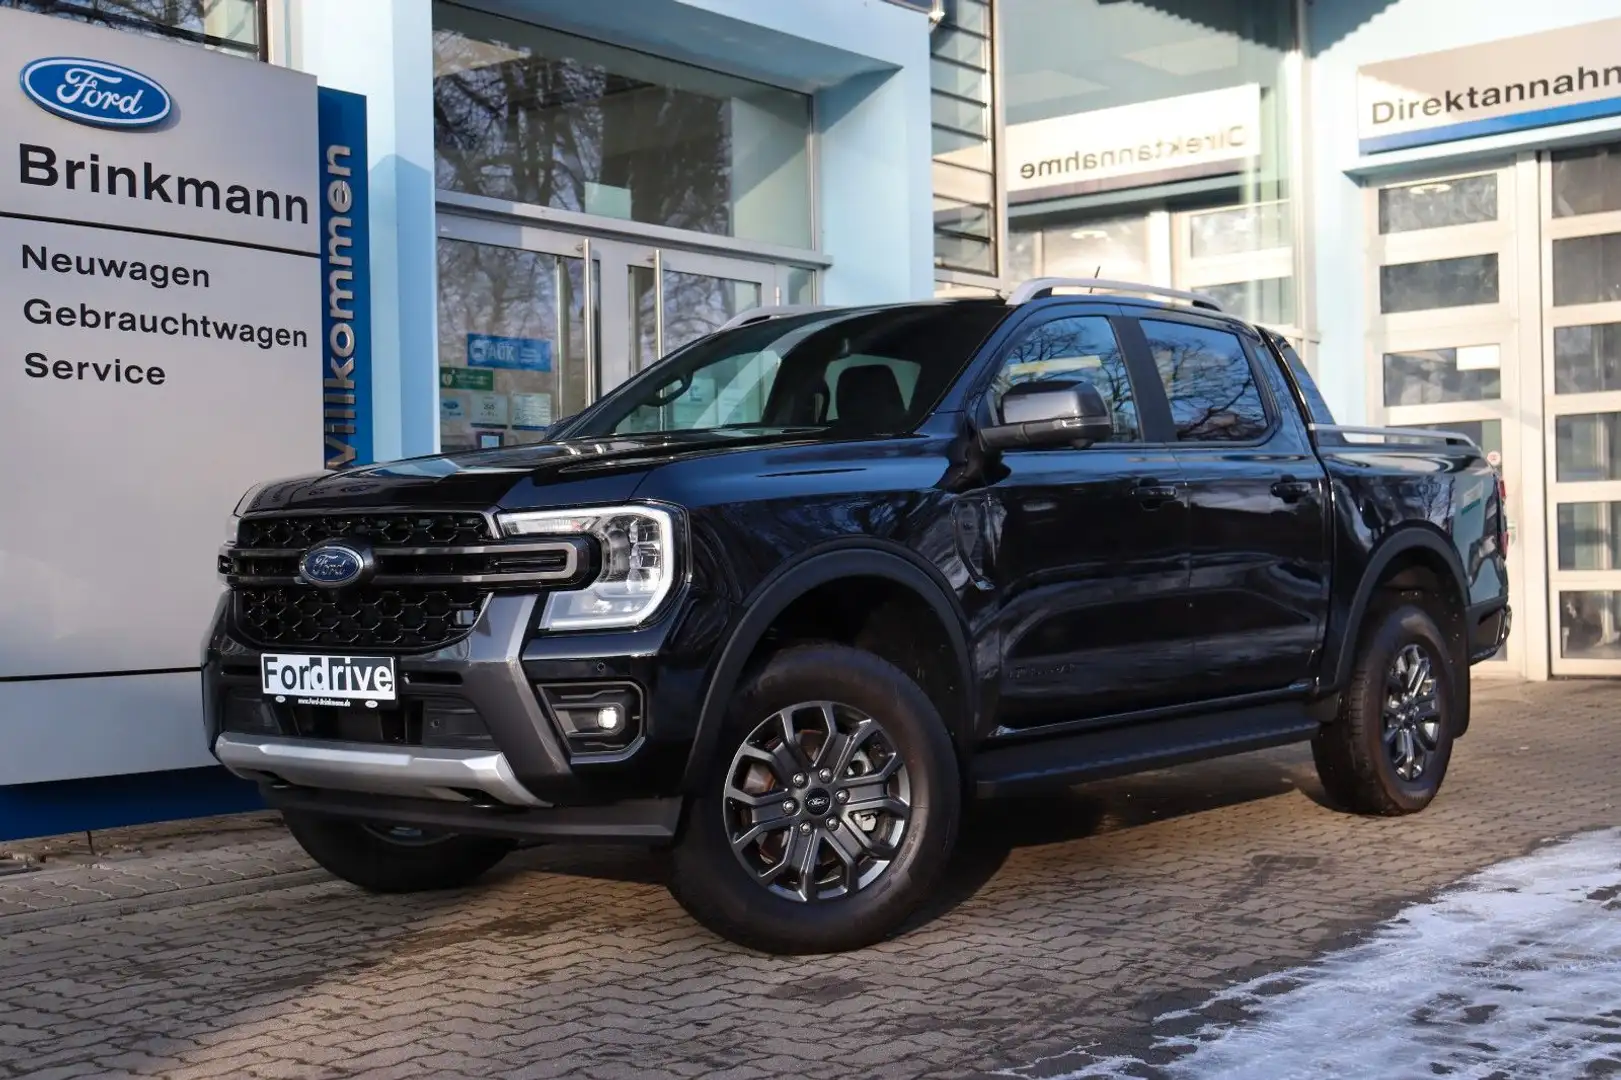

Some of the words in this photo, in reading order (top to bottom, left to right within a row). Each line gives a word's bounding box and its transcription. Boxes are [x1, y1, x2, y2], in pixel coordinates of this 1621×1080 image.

[56, 67, 144, 115] Ford
[19, 142, 309, 226] Brinkmann
[22, 244, 209, 289] Neuwagen
[23, 298, 307, 350] Gebrauchtwagen
[24, 352, 166, 386] Service
[312, 554, 347, 576] Ford
